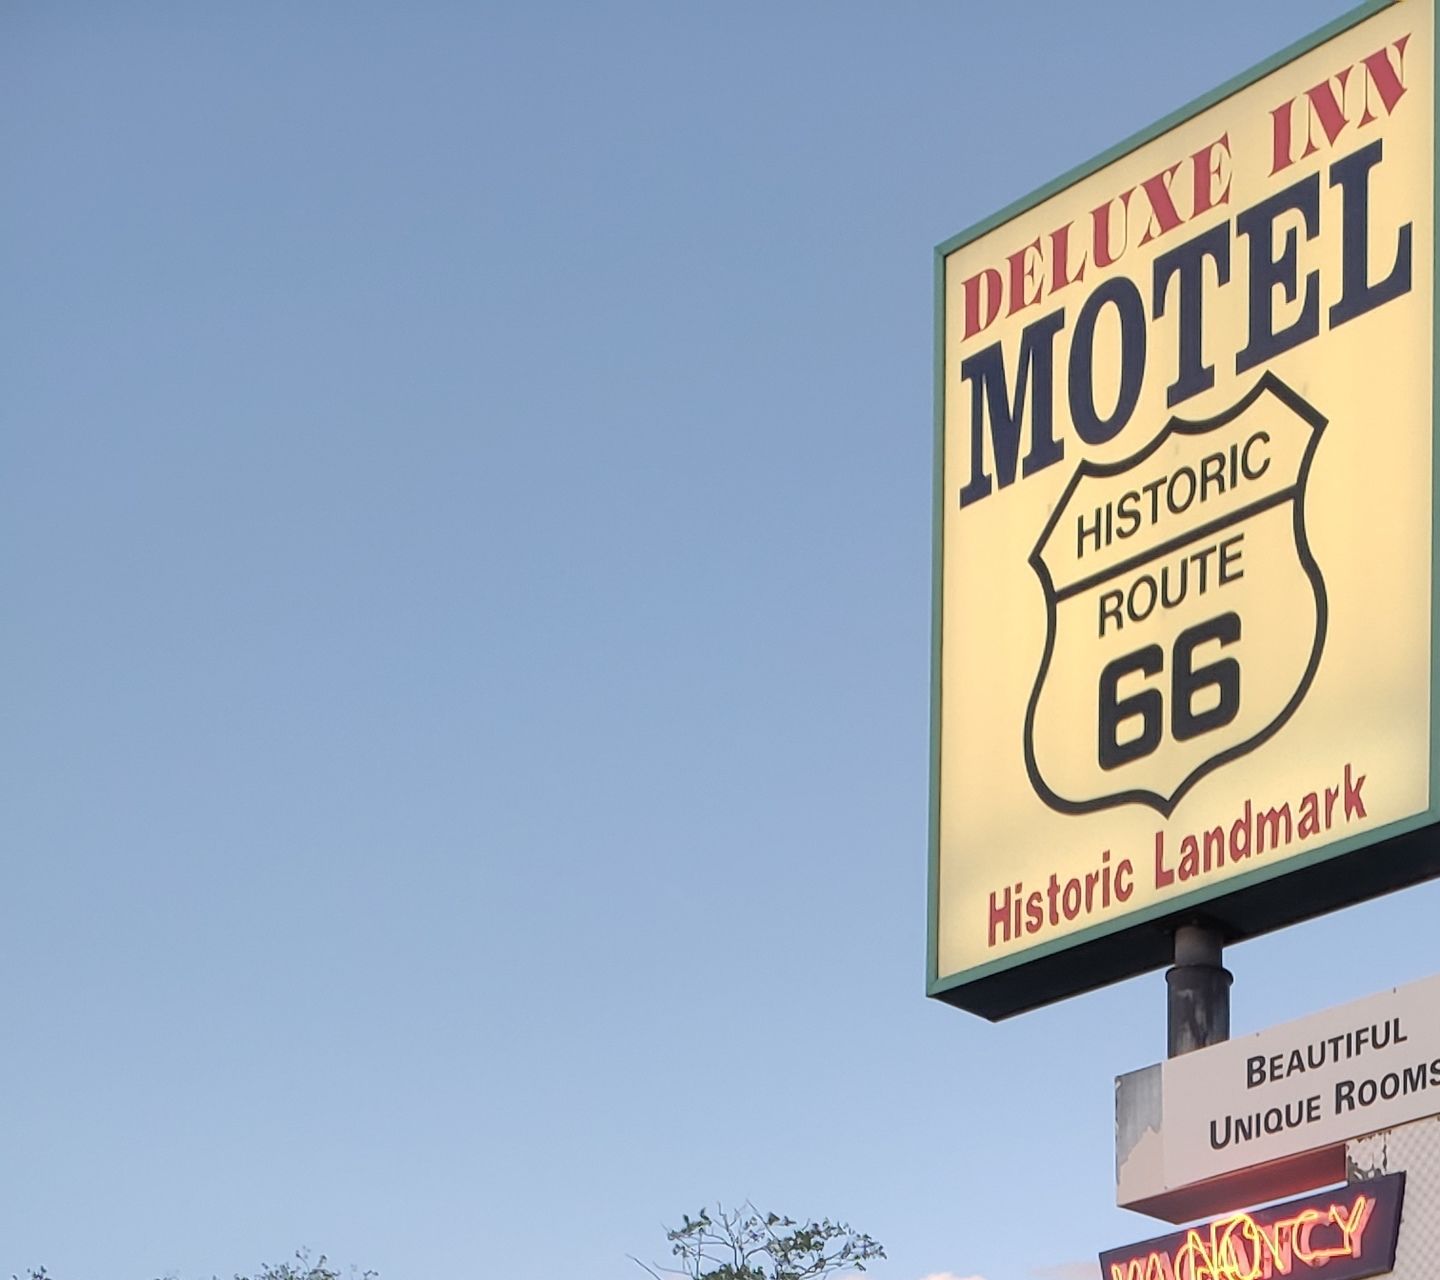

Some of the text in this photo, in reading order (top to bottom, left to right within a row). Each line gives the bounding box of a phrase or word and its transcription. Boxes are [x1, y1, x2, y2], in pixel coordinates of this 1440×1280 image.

[961, 33, 1412, 343] DELUXE INN
[960, 138, 1413, 509] MOTEL
[1077, 431, 1271, 559] HISTORIC
[1099, 533, 1245, 638] ROUTE
[1099, 610, 1241, 770] 66
[988, 763, 1368, 947] Historic Landmark
[1210, 1094, 1321, 1150] UNIQUE
[1246, 1018, 1408, 1089] BEAUTIFUL
